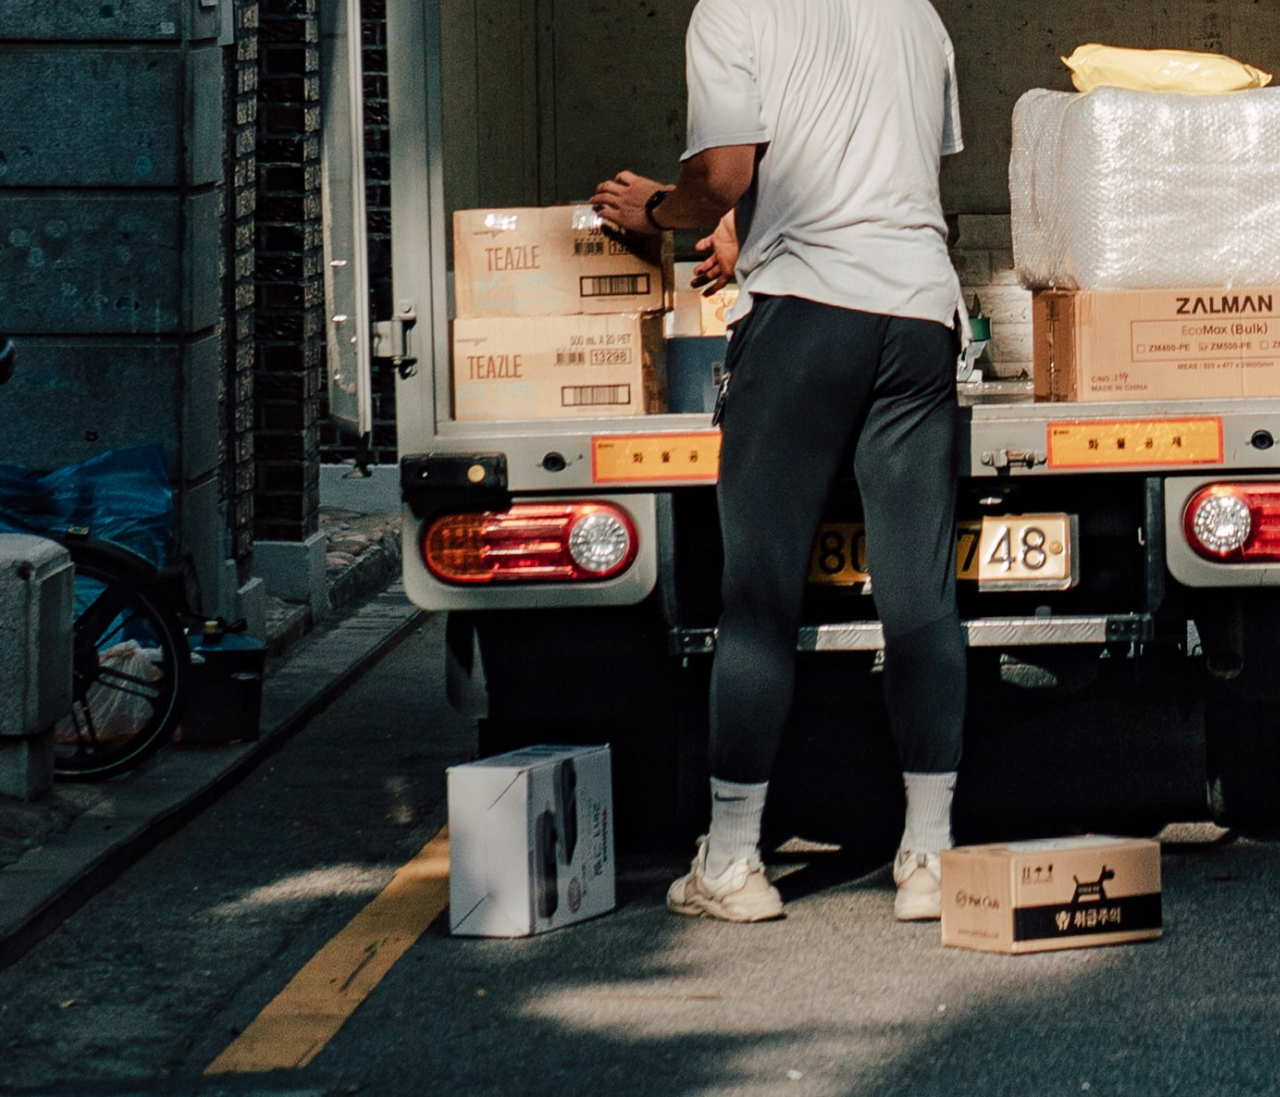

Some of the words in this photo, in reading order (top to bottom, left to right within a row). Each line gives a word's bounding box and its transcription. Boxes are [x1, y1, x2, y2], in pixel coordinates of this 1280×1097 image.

[484, 245, 541, 272] TEAZLE
[1176, 295, 1273, 315] ZALMAN
[1181, 324, 1227, 336] EcoMax
[1231, 322, 1268, 336] (Bulk)
[467, 353, 523, 380] TEAZLE
[593, 350, 628, 363] 13298
[956, 524, 1047, 574] 748
